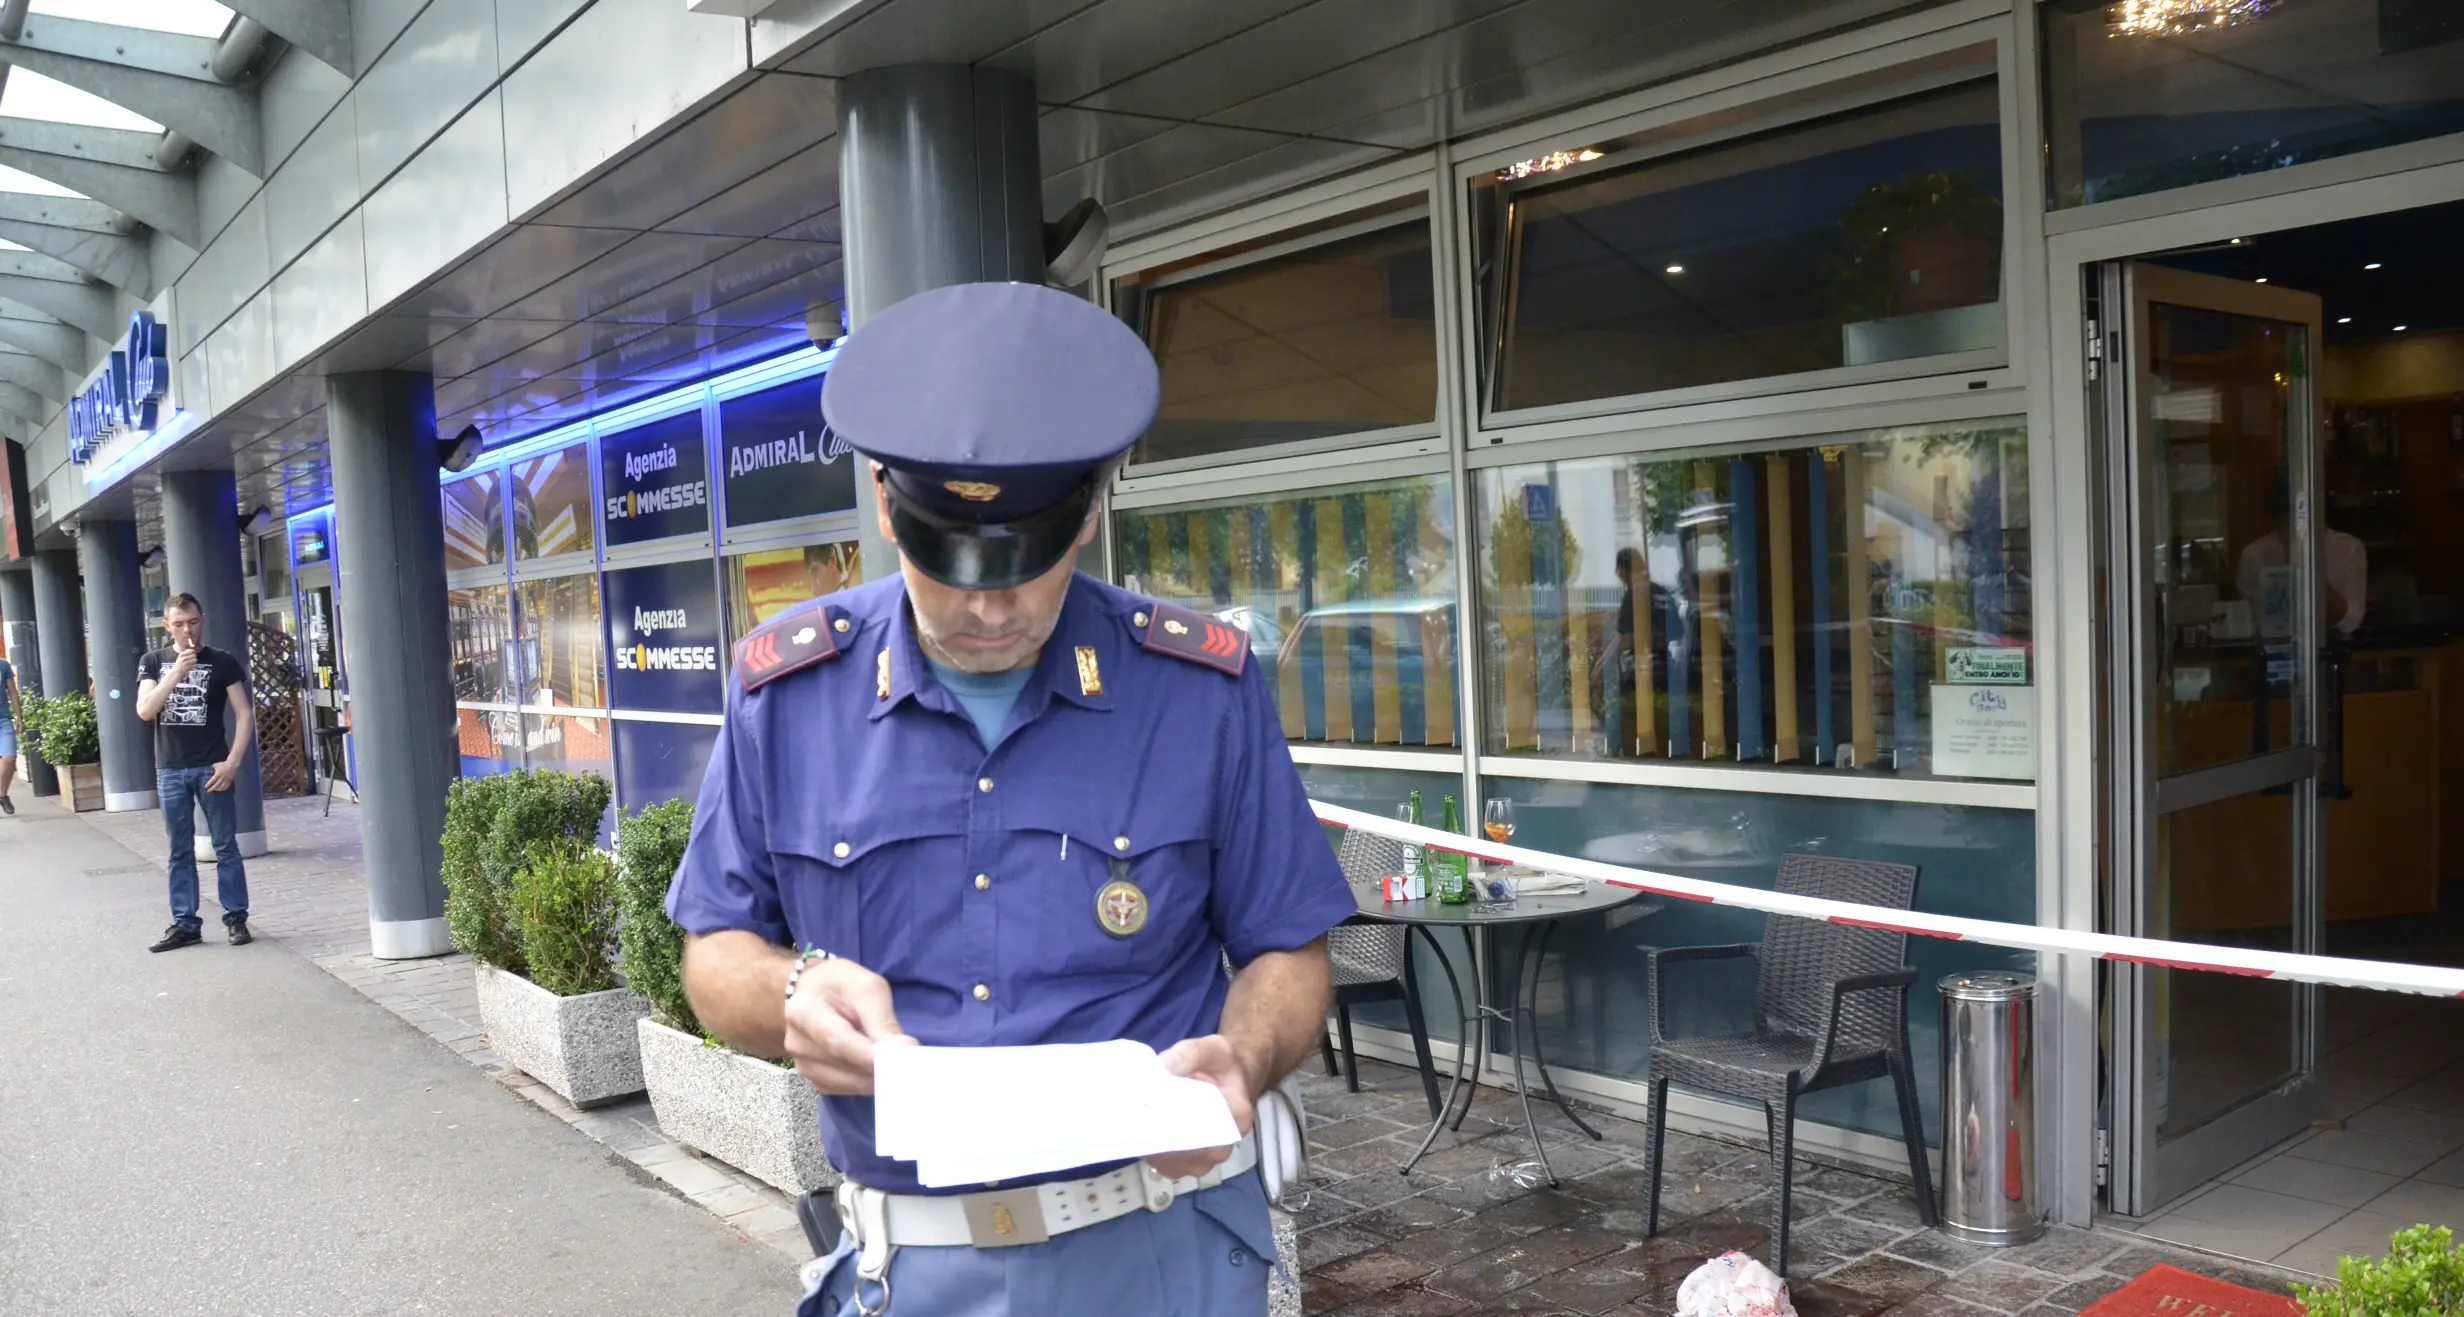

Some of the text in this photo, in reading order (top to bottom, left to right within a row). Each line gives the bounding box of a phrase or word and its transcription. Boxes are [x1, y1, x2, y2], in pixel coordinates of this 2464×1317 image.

[624, 442, 677, 482] Agenzia
[730, 430, 815, 478] ADMIRAL
[606, 480, 706, 520] SCOMMESSE
[633, 605, 687, 637] Agenzia
[616, 643, 716, 672] SCOMMESSE
[1969, 689, 2006, 710] City
